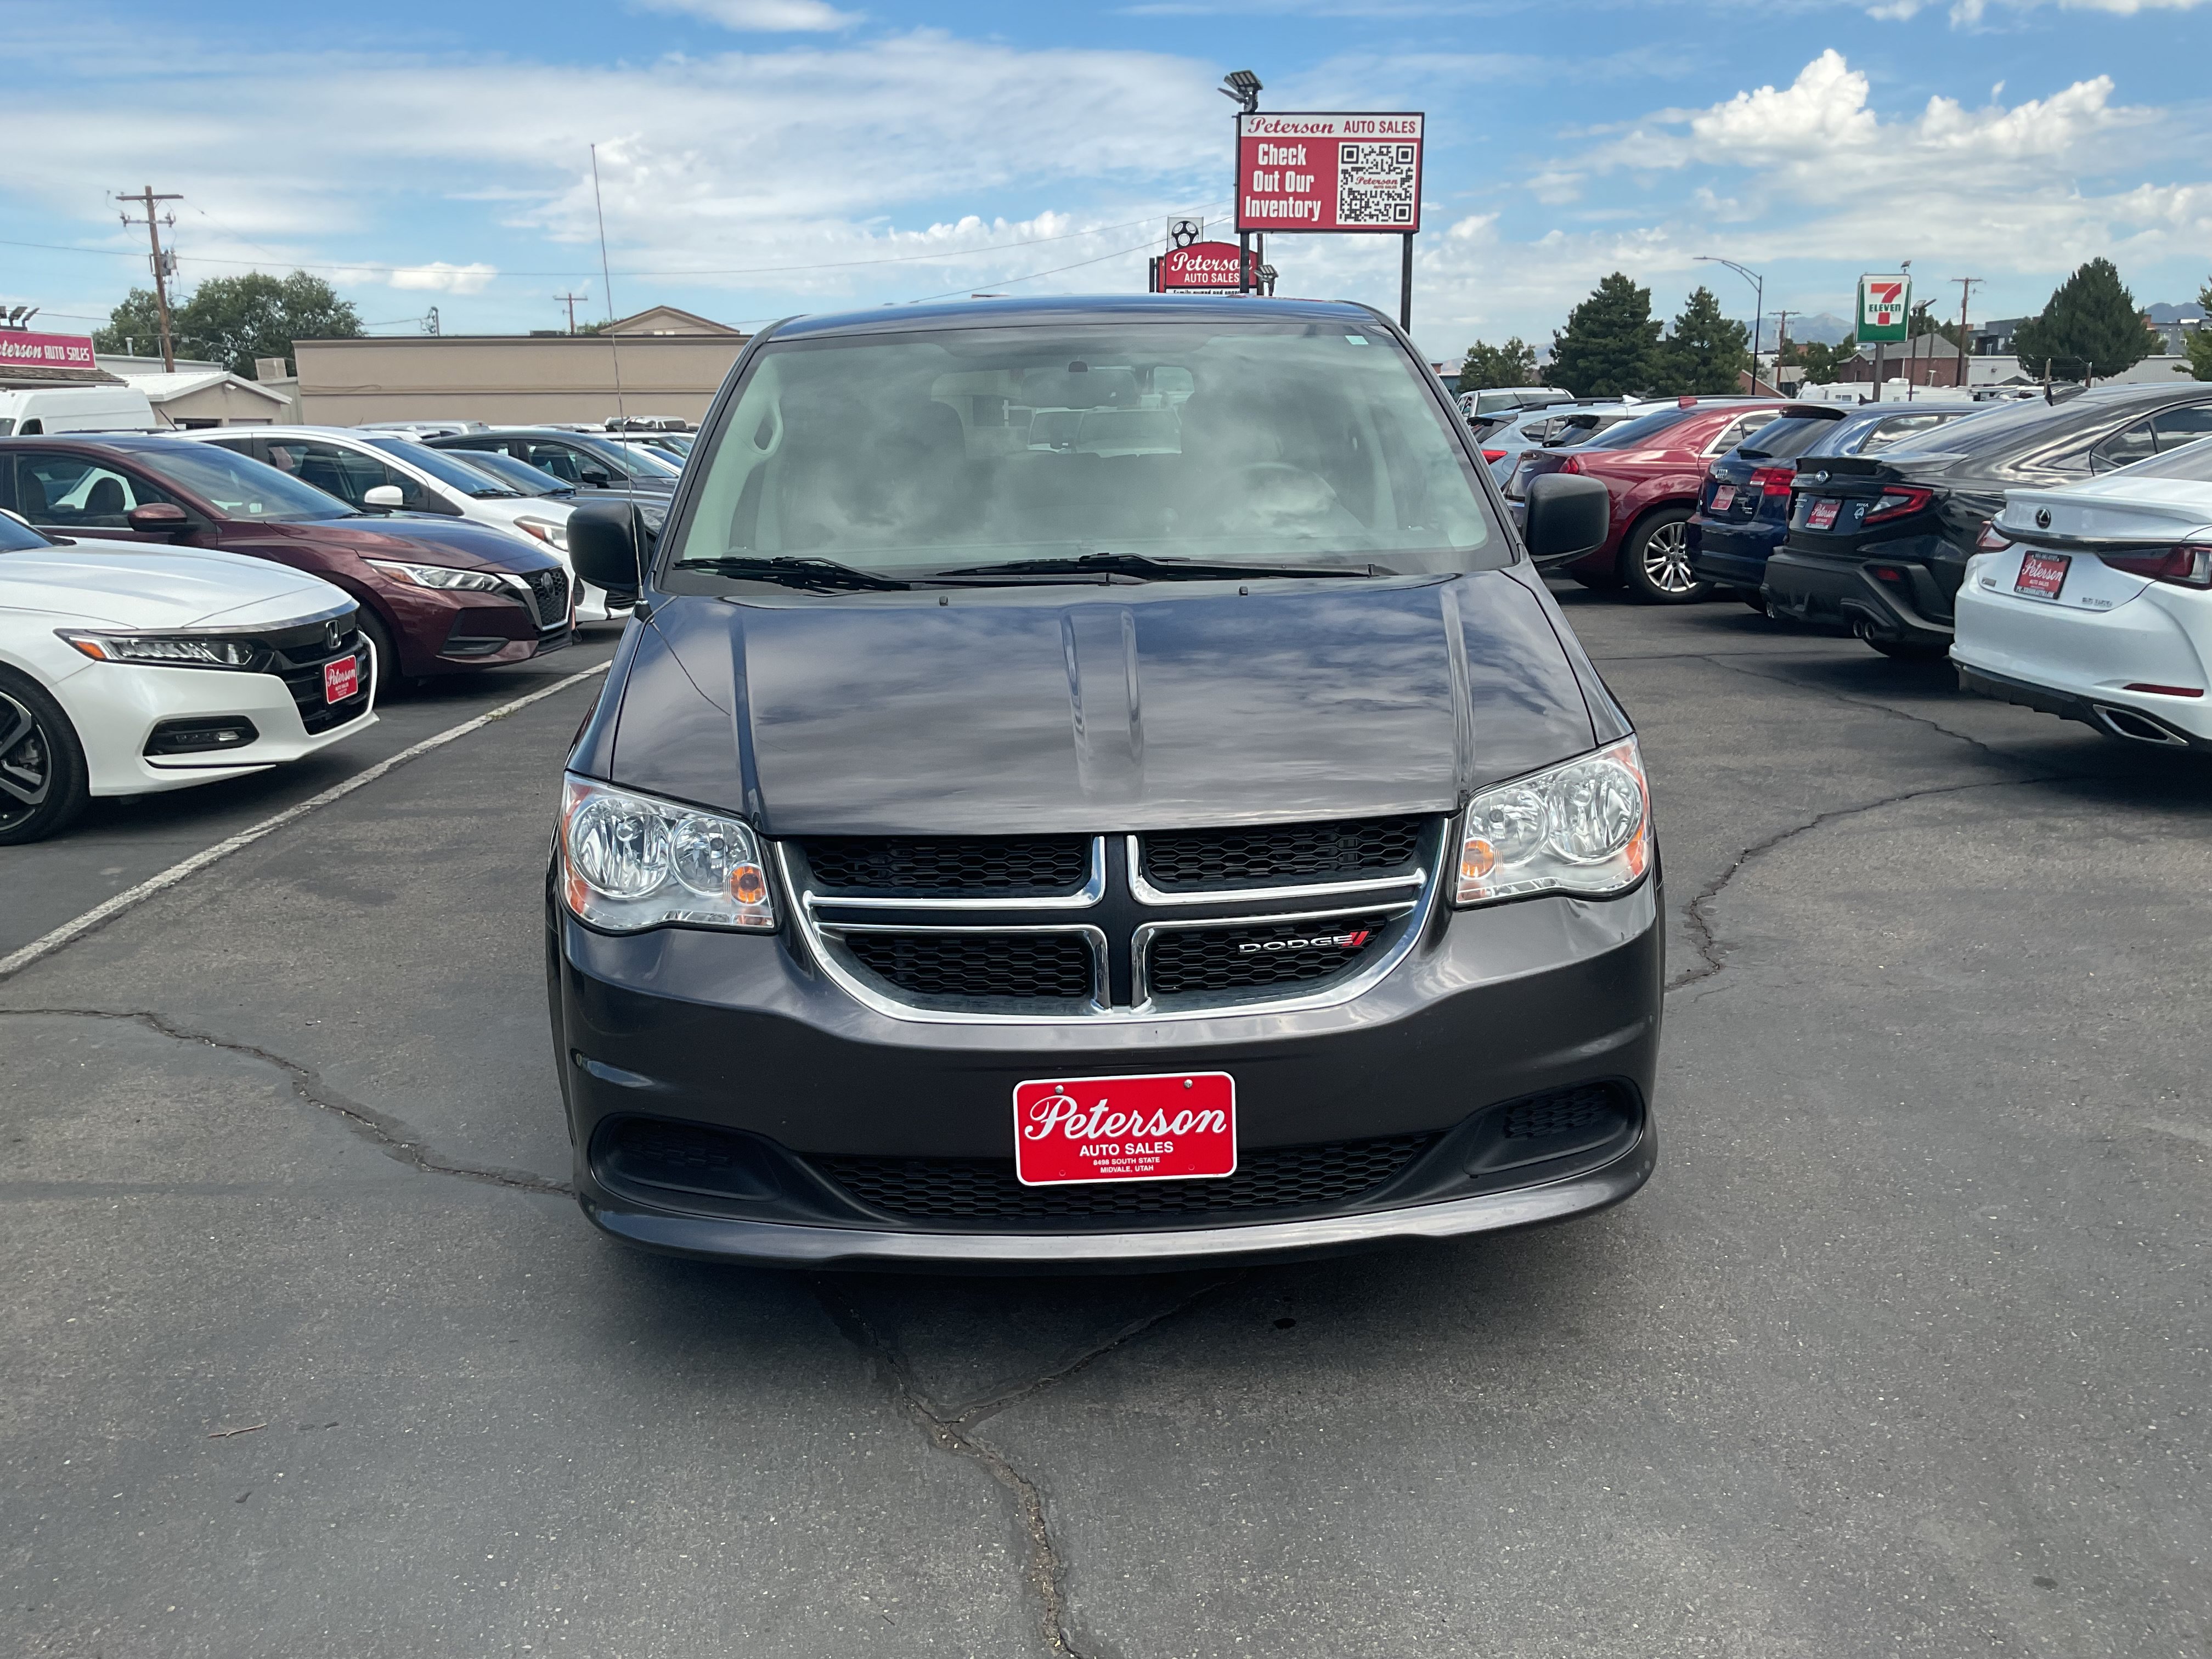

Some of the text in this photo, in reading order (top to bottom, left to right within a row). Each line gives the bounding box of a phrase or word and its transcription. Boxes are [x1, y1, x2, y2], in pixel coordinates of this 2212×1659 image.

[1248, 117, 1415, 134] Peterson AUTO SALES
[1258, 143, 1306, 165] Check
[1253, 171, 1314, 193] Out Our
[1355, 176, 1398, 185] Peterson
[1245, 196, 1322, 222] Inventory
[1171, 252, 1252, 272] Peterso
[1184, 273, 1240, 283] AUTO SALES
[1871, 283, 1902, 324] 7
[0, 340, 90, 361] terson AUTO SALES
[2022, 558, 2063, 582] Peterson
[328, 669, 356, 687] Peterson
[1239, 935, 1353, 953] DODGE
[1025, 1094, 1227, 1140] Peterson
[1079, 1141, 1173, 1157] AUTO SALES
